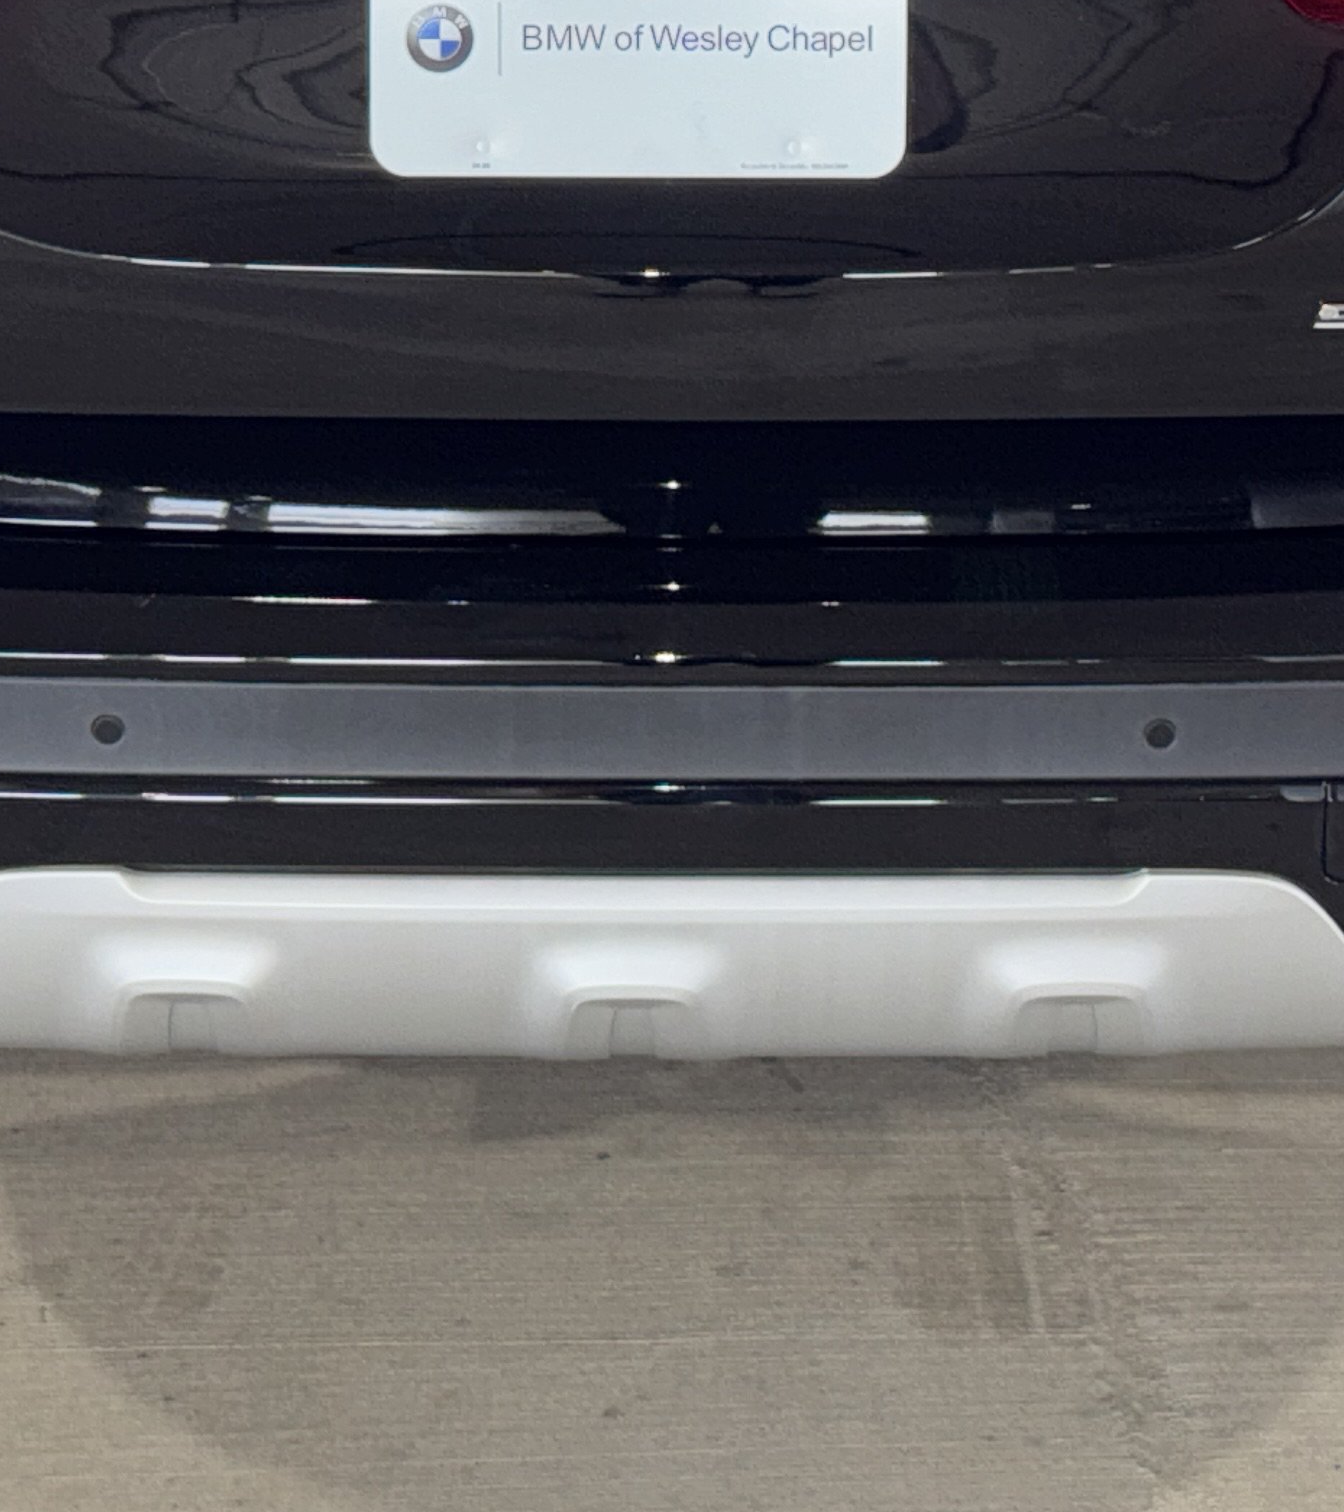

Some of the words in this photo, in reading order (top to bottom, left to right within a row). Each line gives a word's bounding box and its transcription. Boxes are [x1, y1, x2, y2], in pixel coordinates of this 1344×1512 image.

[522, 23, 607, 51] BMW
[614, 23, 645, 51] of
[649, 23, 759, 59] Wesley
[767, 23, 874, 58] Chapel
